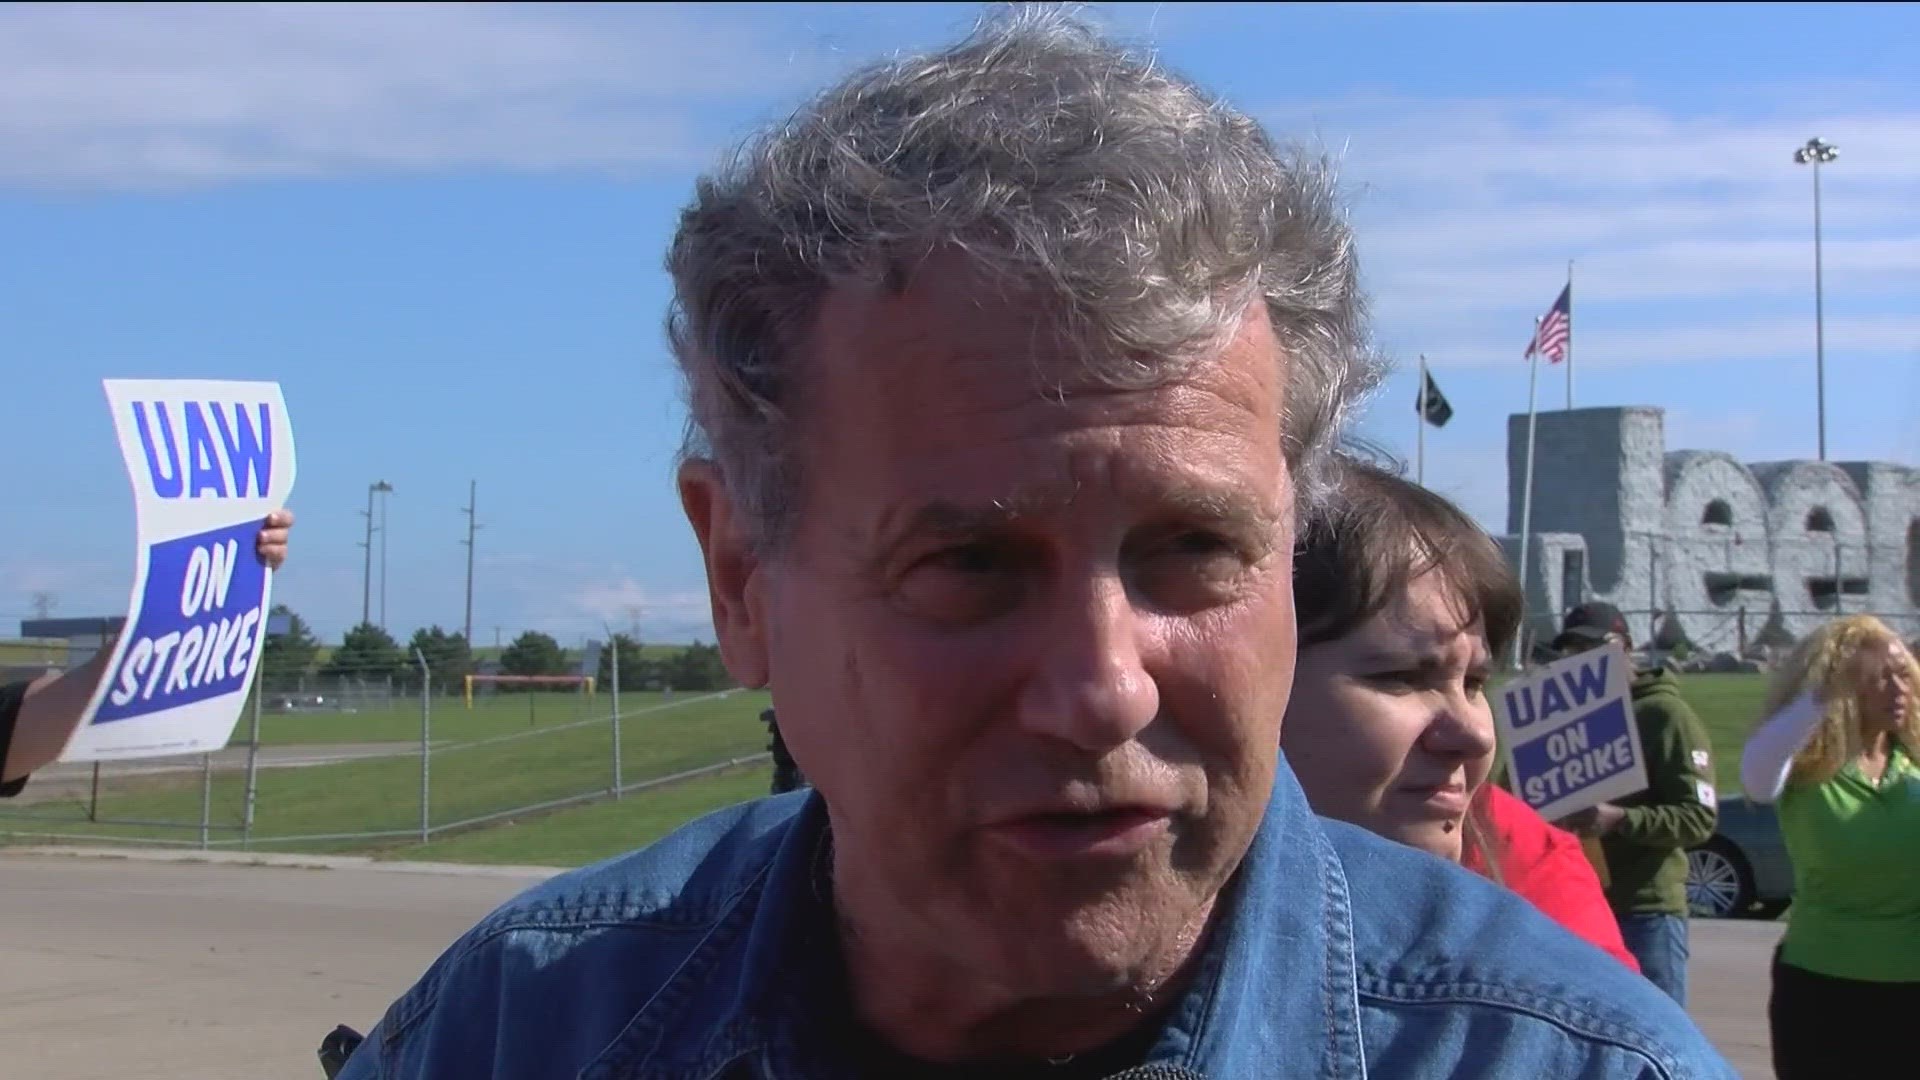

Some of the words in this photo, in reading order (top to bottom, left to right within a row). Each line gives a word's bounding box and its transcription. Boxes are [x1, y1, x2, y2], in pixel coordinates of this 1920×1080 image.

[131, 400, 272, 498] UAW
[180, 538, 239, 618] ON
[110, 605, 260, 707] STRIKE
[1504, 654, 1610, 729] UAW
[1524, 734, 1632, 804] STRIKE
[1545, 721, 1589, 763] ON
